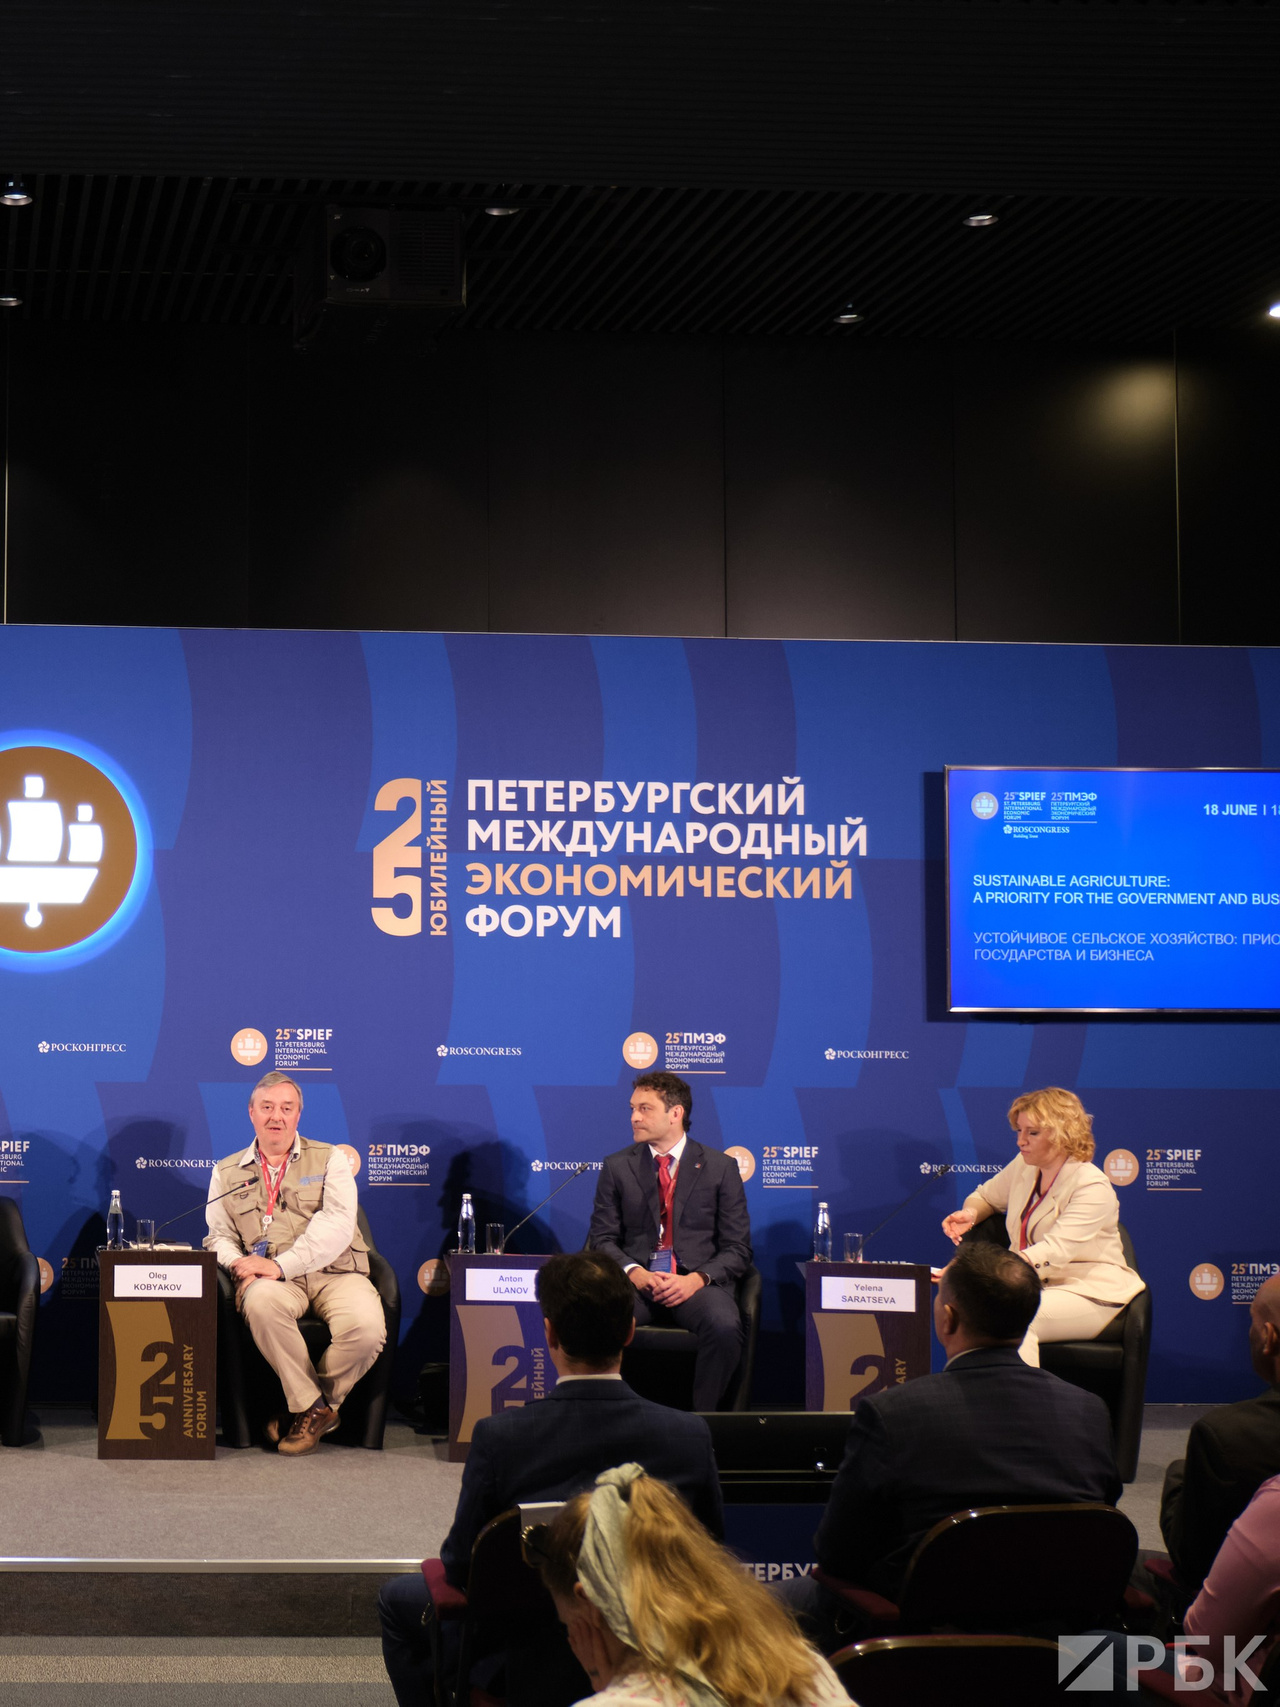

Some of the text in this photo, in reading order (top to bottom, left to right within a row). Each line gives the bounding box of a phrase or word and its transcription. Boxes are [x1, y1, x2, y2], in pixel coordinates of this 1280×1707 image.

[467, 776, 805, 815] ПЕТЕРБУРГСКИЙ
[1204, 804, 1258, 816] 18 JUNE
[467, 817, 867, 859] МЕЖДУНАРОДНЫЙ
[426, 779, 447, 936] ЮБИЛЕЙНЫЙ
[465, 860, 852, 899] ЭКОНОМИЧЕСКИЙ
[973, 874, 1170, 888] SUSTAINABLE AGRICULTURE:
[973, 892, 983, 903] A
[986, 892, 1048, 904] PRIORITY
[1054, 892, 1083, 904] FOR
[1086, 892, 1113, 904] THE
[1118, 892, 1215, 905] GOVERNMENT
[1218, 893, 1247, 904] AND
[465, 904, 621, 938] ФОРУМ
[974, 930, 1067, 944] УСТОЙЧИВОЕ
[1072, 932, 1146, 945] СЕЛЬСКОЕ
[1150, 932, 1238, 945] ХОЗЯЙСТВО:
[974, 949, 1154, 962] ГОСУДАРСТВА И БИЗНЕСА
[51, 1043, 126, 1052] РОСКОНГРЕСС
[450, 1046, 521, 1055] ROSCONGRESS
[837, 1050, 909, 1059] РОСКОНГРЕСС
[148, 1159, 219, 1168] ROSCONGRES
[148, 1272, 167, 1281] Oleg
[498, 1275, 523, 1283] Anton
[134, 1283, 182, 1292] KOBYAKOV
[493, 1286, 528, 1294] ULANOV
[841, 1295, 896, 1304] SARATSEVA
[183, 1344, 194, 1438] ANNIVERSARY
[196, 1390, 206, 1439] FORUM
